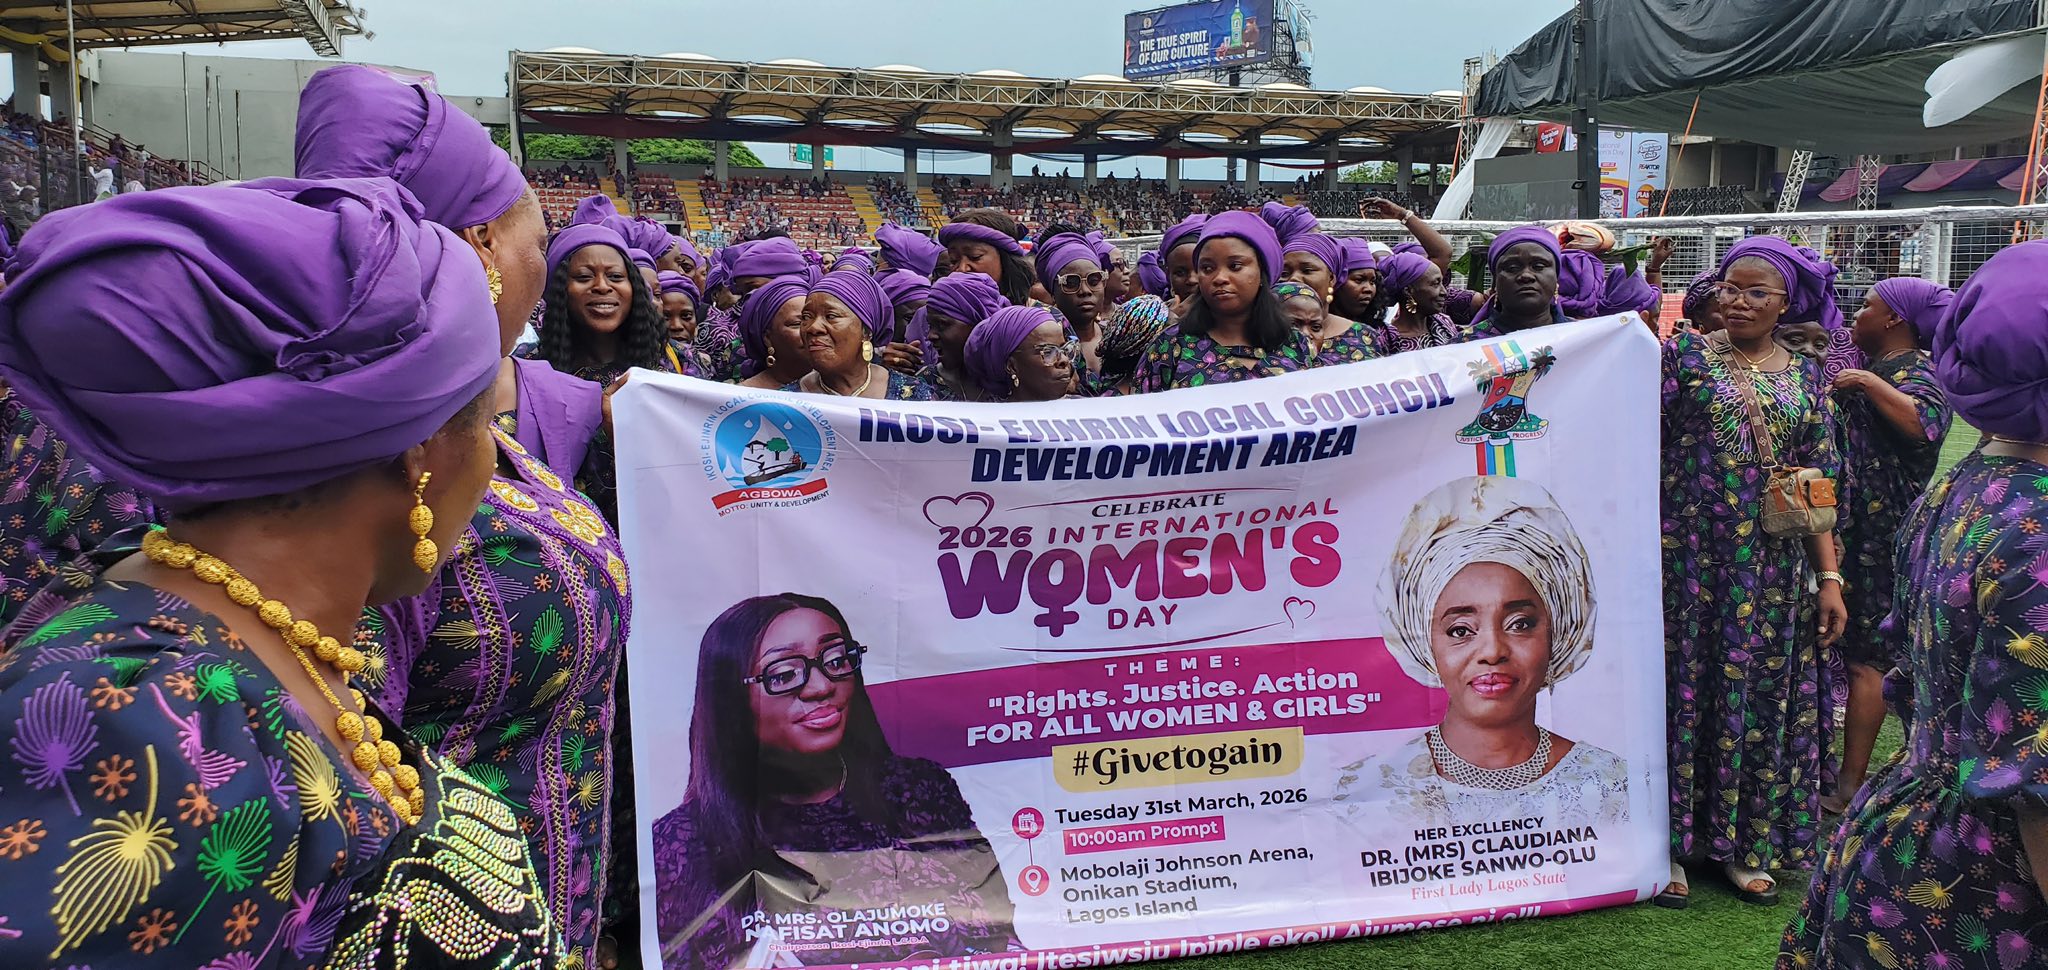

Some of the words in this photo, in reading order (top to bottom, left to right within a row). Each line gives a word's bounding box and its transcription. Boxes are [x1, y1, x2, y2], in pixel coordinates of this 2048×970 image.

[1138, 52, 1150, 66] OF
[1151, 49, 1169, 64] OUR
[1170, 43, 1209, 60] CULTURE
[1139, 39, 1155, 52] THE
[1156, 35, 1178, 50] TRUE
[1179, 30, 1208, 46] SPIRIT
[859, 407, 994, 443] IKOSI-
[999, 414, 1158, 443] EJINRIN
[1157, 402, 1284, 438] LOCAL
[1283, 373, 1455, 425] COUNCIL
[701, 414, 719, 450] EJINRIN
[718, 395, 747, 415] LOCAL
[795, 398, 837, 450] DEVELOPMENT
[820, 451, 836, 473] AREA
[1512, 430, 1543, 439] PROGRESS
[971, 435, 1259, 482] DEVELOPMENT
[1260, 425, 1357, 467] AREA
[718, 502, 750, 517] MOTTO:
[750, 500, 773, 509] UNITY
[781, 490, 830, 508] DEVELOPMENT
[738, 489, 803, 499] AGBOWA
[1091, 492, 1226, 517] CELEBRATE
[938, 525, 1033, 550] 2026
[1048, 497, 1339, 544] INTERNATIONAL
[937, 521, 1341, 637] WOMEN'S
[1108, 604, 1178, 630] DAY
[988, 689, 1117, 717] "Rights.
[1122, 676, 1245, 704] Justice.
[1251, 668, 1358, 695] Action
[967, 720, 1034, 747] FOR
[1040, 713, 1101, 738] ALL
[1106, 701, 1238, 732] WOMEN
[1246, 700, 1267, 721] &
[1272, 692, 1381, 719] GIRLS"
[1072, 737, 1283, 785] #Givetogain
[1055, 802, 1139, 824] Tuesday
[1144, 800, 1182, 816] 31st
[1188, 793, 1255, 813] March,
[1260, 788, 1308, 806] 2026
[1069, 828, 1146, 848] 10:00am
[1150, 821, 1218, 840] Prompt
[1414, 828, 1447, 841] HER
[1452, 817, 1544, 838] EXCLLENCY
[1361, 849, 1398, 867] DR.
[1404, 840, 1465, 866] (MRS)
[1472, 826, 1598, 854] CLAUDIANA
[1060, 859, 1149, 882] Mobolaji
[1155, 852, 1242, 874] Johnson
[1249, 847, 1314, 865] Arena,
[1370, 863, 1456, 887] IBIJOKE
[1460, 846, 1597, 877] SANWO-OLU
[1063, 882, 1140, 903] Onikan
[1144, 873, 1237, 896] Stadium,
[1411, 886, 1445, 900] First
[1449, 881, 1483, 897] Lady
[1488, 876, 1528, 892] Lagos
[1533, 872, 1566, 885] State
[741, 910, 770, 929] DR.
[775, 913, 822, 924] MRS.
[826, 903, 946, 923] OLAJUMOKE
[1067, 903, 1130, 924] Lagos
[1135, 896, 1198, 917] Island
[745, 924, 847, 942] NAFISAT
[854, 917, 950, 938] ANOMO
[769, 942, 830, 952] Chairperson
[831, 938, 889, 949] Ikosi-Ejinrin
